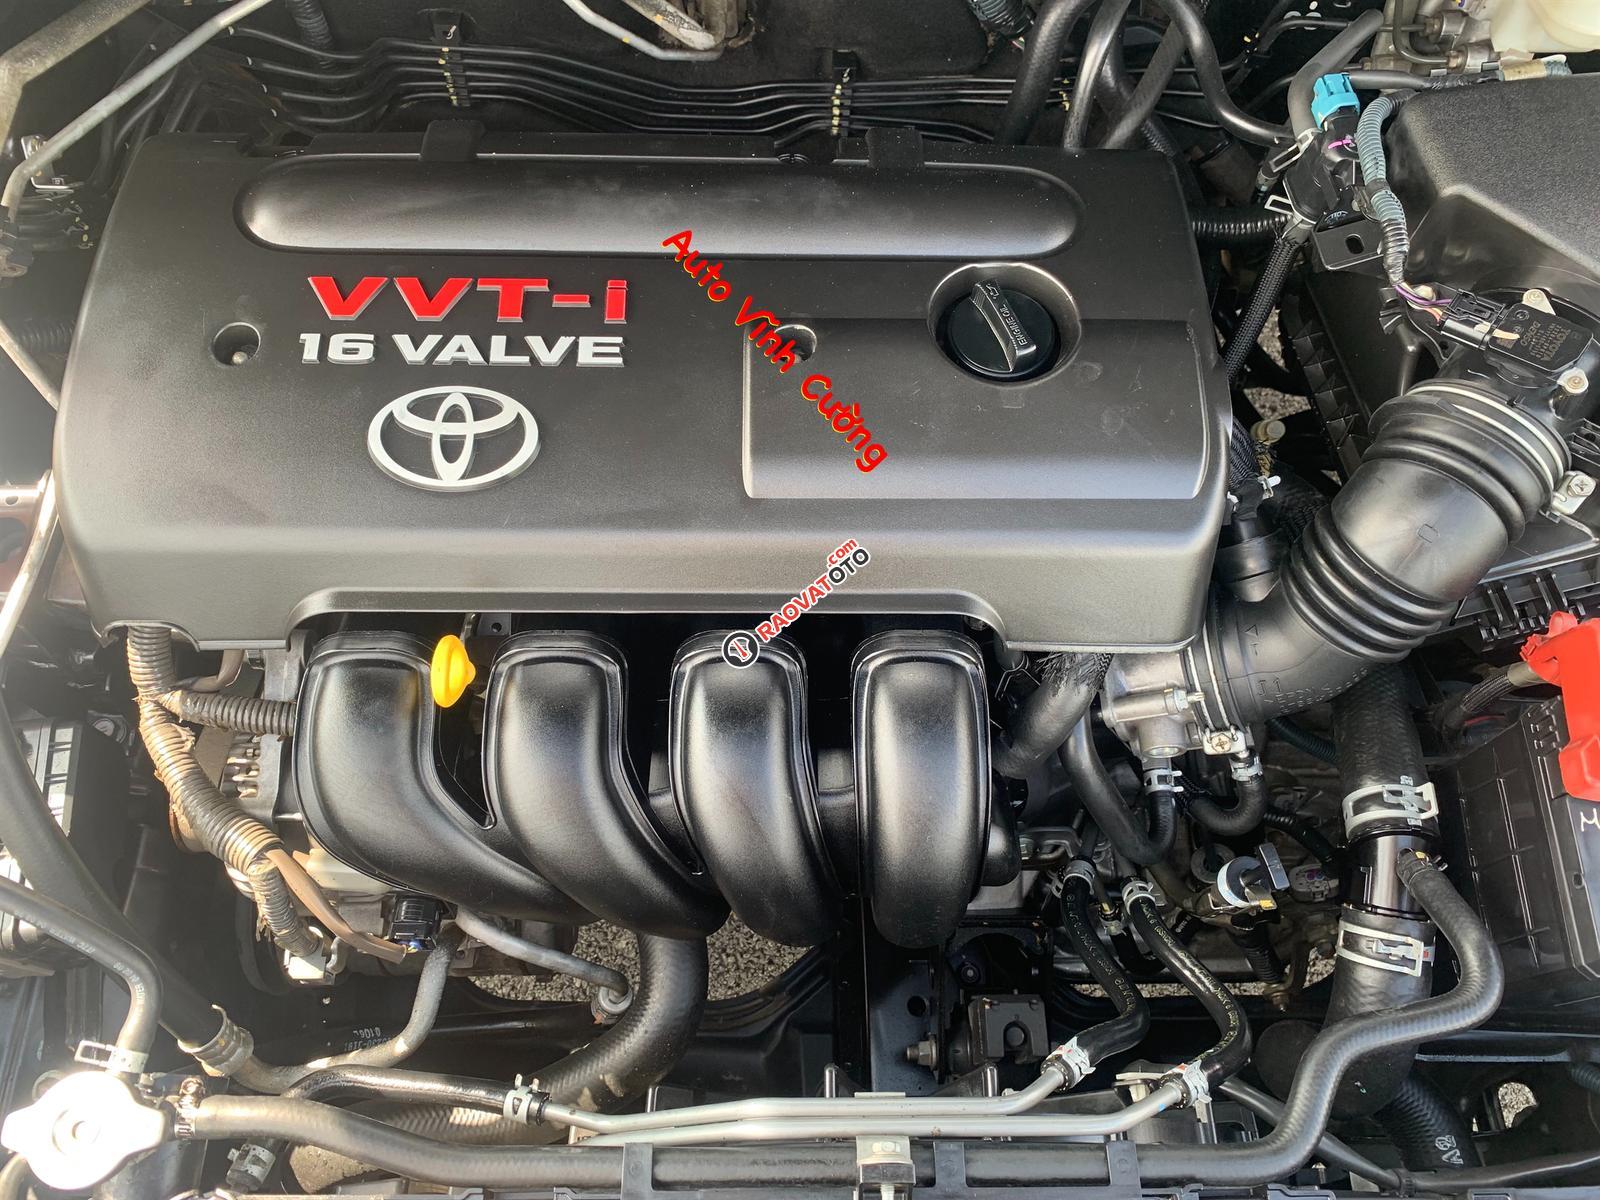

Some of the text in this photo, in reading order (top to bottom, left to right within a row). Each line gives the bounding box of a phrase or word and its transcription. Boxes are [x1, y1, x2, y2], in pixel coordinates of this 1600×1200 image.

[308, 276, 627, 324] VVT-i
[999, 303, 1028, 346] ENGINE OIL
[299, 333, 624, 367] 16 VALVE
[1541, 328, 1571, 361] TOYOTA
